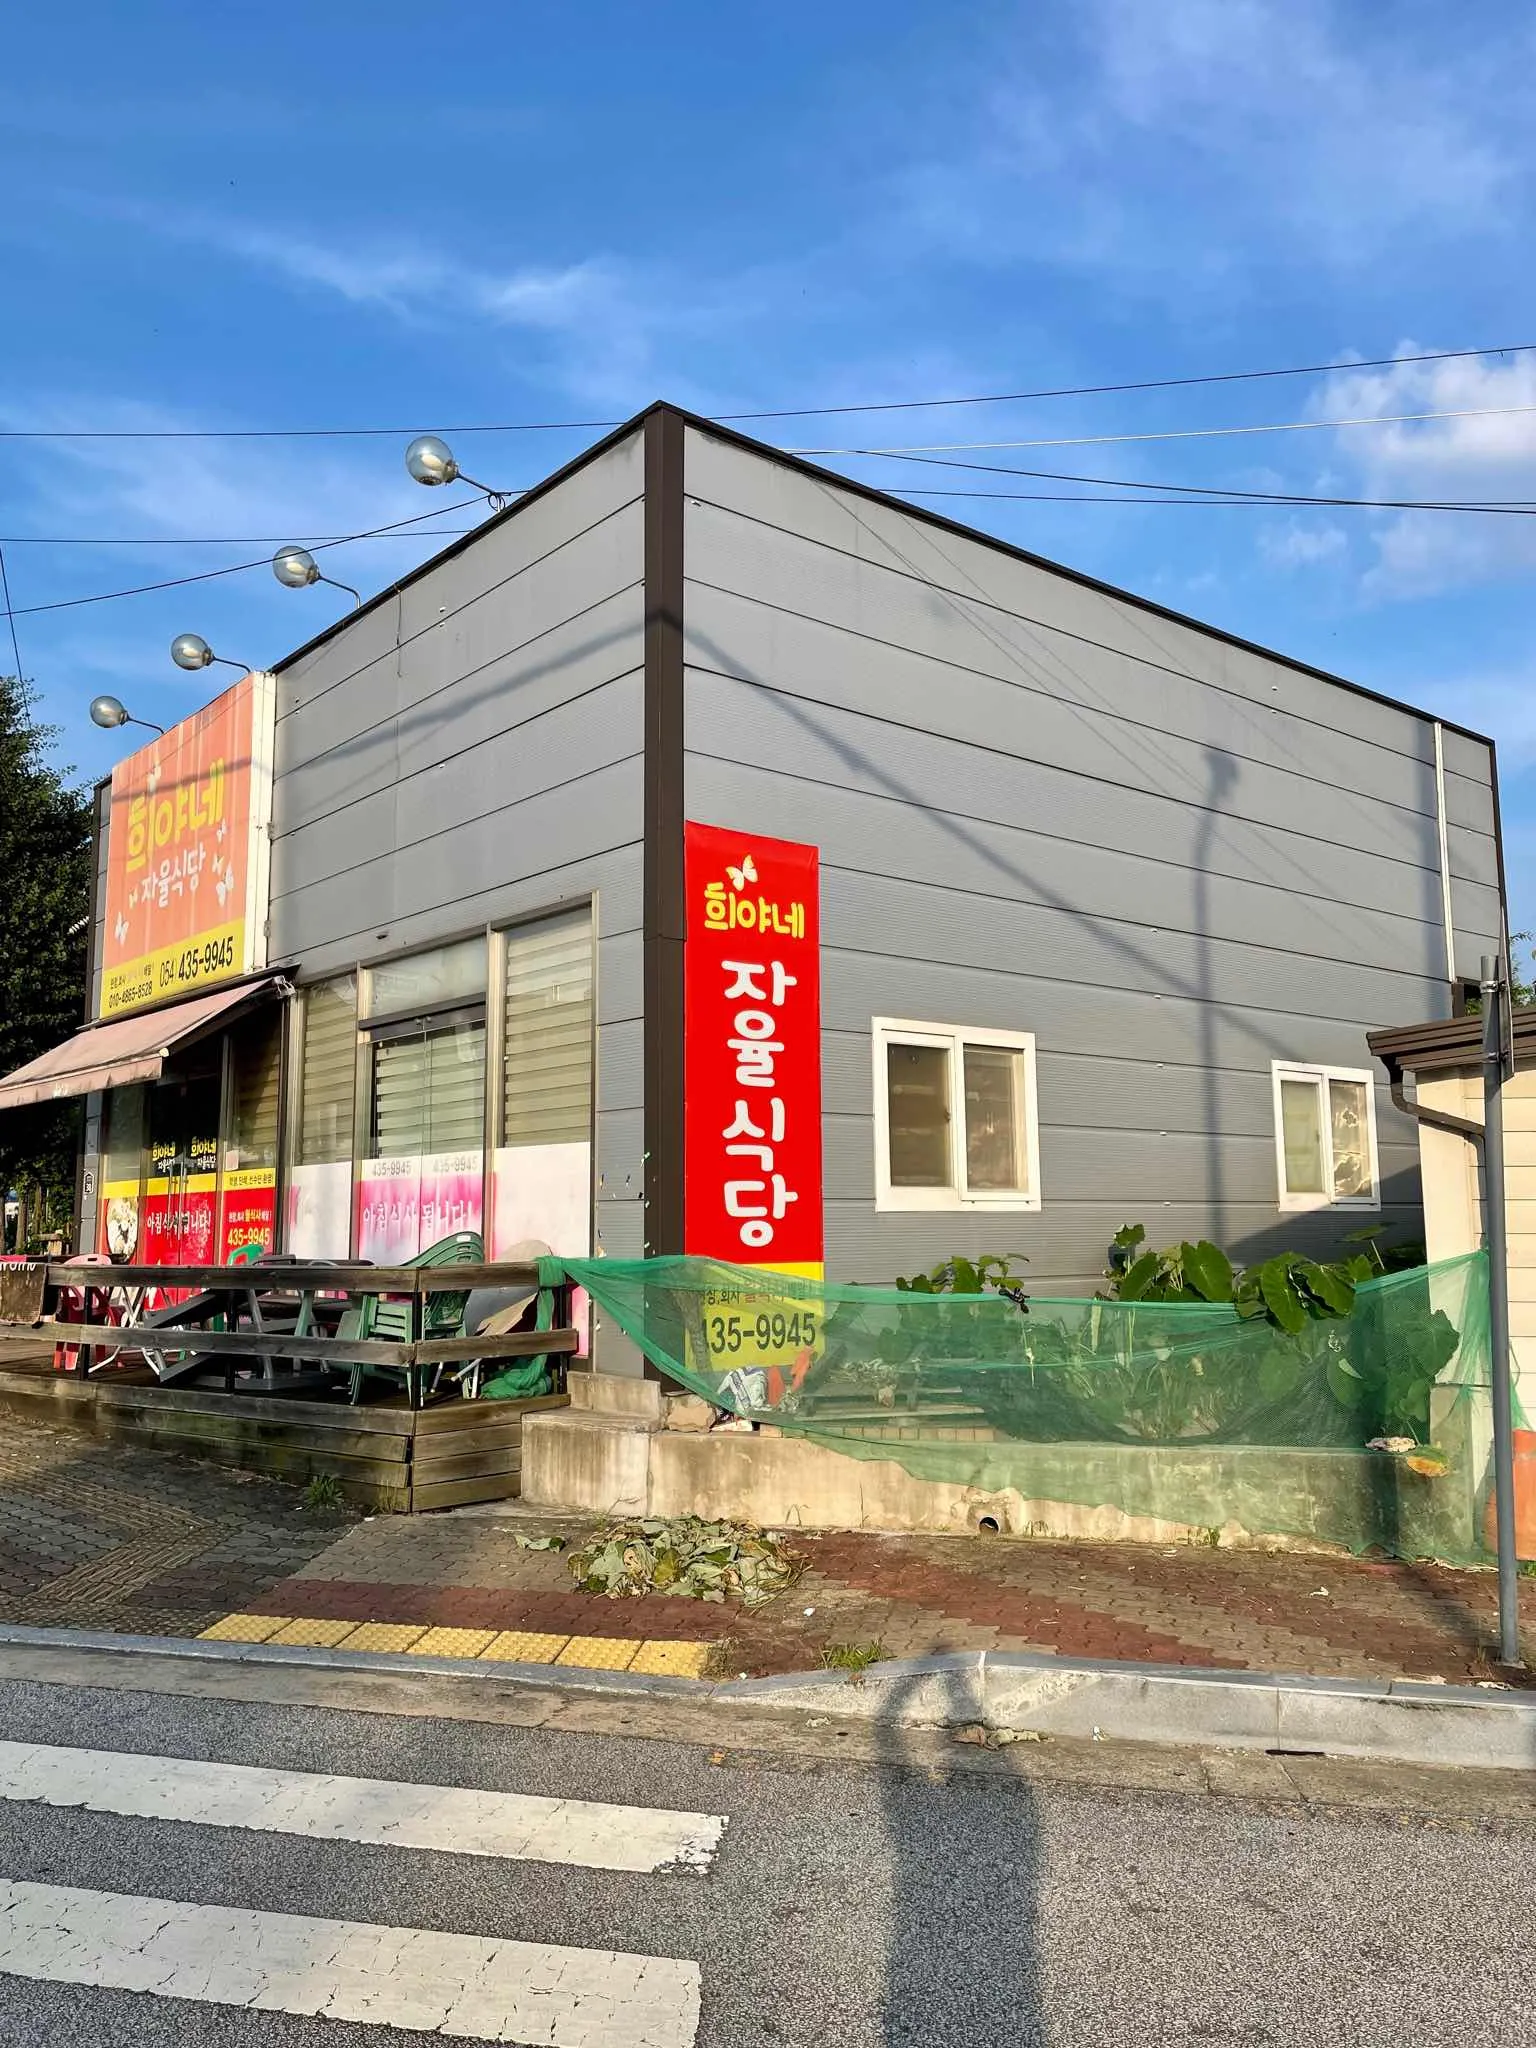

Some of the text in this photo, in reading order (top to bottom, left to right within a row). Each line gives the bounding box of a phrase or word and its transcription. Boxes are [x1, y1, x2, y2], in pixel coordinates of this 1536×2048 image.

[126, 757, 225, 873] 희야네
[141, 842, 206, 908] 자율식당
[704, 882, 805, 939] 희야네
[178, 936, 234, 981] 435-9945
[722, 958, 798, 1248] 자율식당
[152, 1141, 176, 1162] 희야네
[190, 1135, 217, 1157] 희야네
[373, 1161, 412, 1177] 435-9945
[228, 1227, 271, 1246] 435-9945
